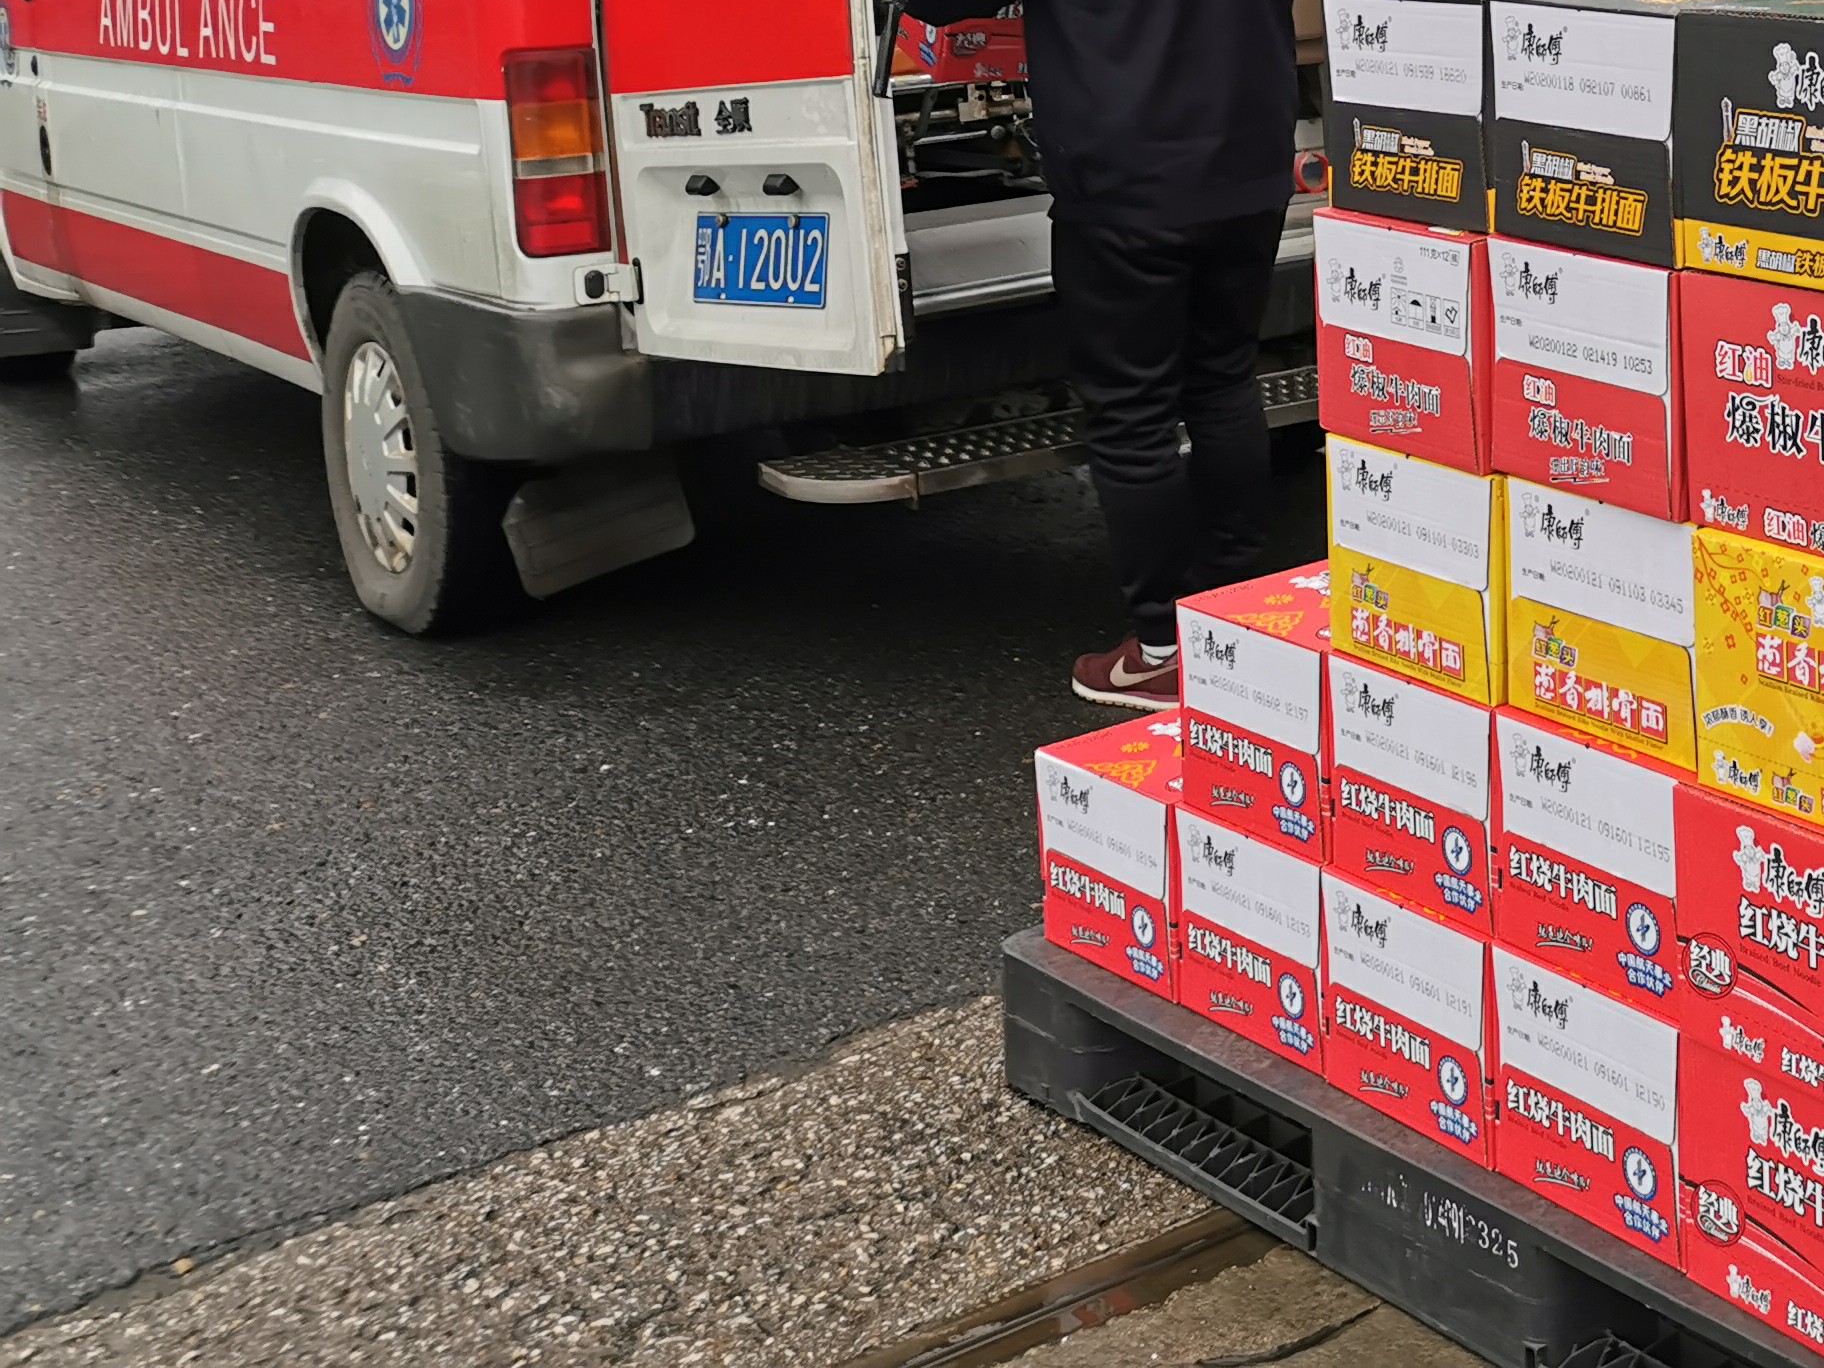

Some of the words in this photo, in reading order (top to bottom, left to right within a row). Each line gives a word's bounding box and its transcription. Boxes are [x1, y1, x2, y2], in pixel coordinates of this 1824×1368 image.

[1521, 23, 1564, 66] 康師傅
[1524, 70, 1574, 91] W20200118
[639, 101, 701, 137] Transit
[1735, 113, 1803, 152] 黑胡椒
[1351, 150, 1462, 203] 铁板牛排面
[1517, 176, 1647, 235] 铁板牛排面
[1518, 261, 1559, 305] 康師傅
[1344, 334, 1374, 363] 红油
[1528, 334, 1578, 358] W20200122
[1582, 348, 1618, 367] 021419
[1623, 355, 1653, 374] 10253
[1715, 340, 1773, 388] 红油
[1350, 364, 1441, 417] 爆椒牛肉面
[1523, 374, 1556, 406] 红油
[1527, 409, 1634, 468] 爆椒牛肉面
[1539, 503, 1585, 551] 康師傅
[1351, 606, 1464, 681] 葱香排骨面
[1757, 605, 1811, 638] 红葱头
[1534, 661, 1667, 743] 葱香排骨面
[1189, 719, 1274, 778] 红烧牛肉面
[1340, 778, 1436, 844] 红烧牛肉面
[1049, 862, 1126, 921] 红烧牛肉面
[1508, 845, 1618, 920] 红烧牛肉面
[1187, 921, 1272, 988] 红烧牛肉面
[1689, 941, 1732, 985] 经典
[1334, 995, 1431, 1071] 红烧牛肉面
[1506, 1078, 1615, 1163] 红烧牛肉面
[1698, 1185, 1738, 1232] 经典
